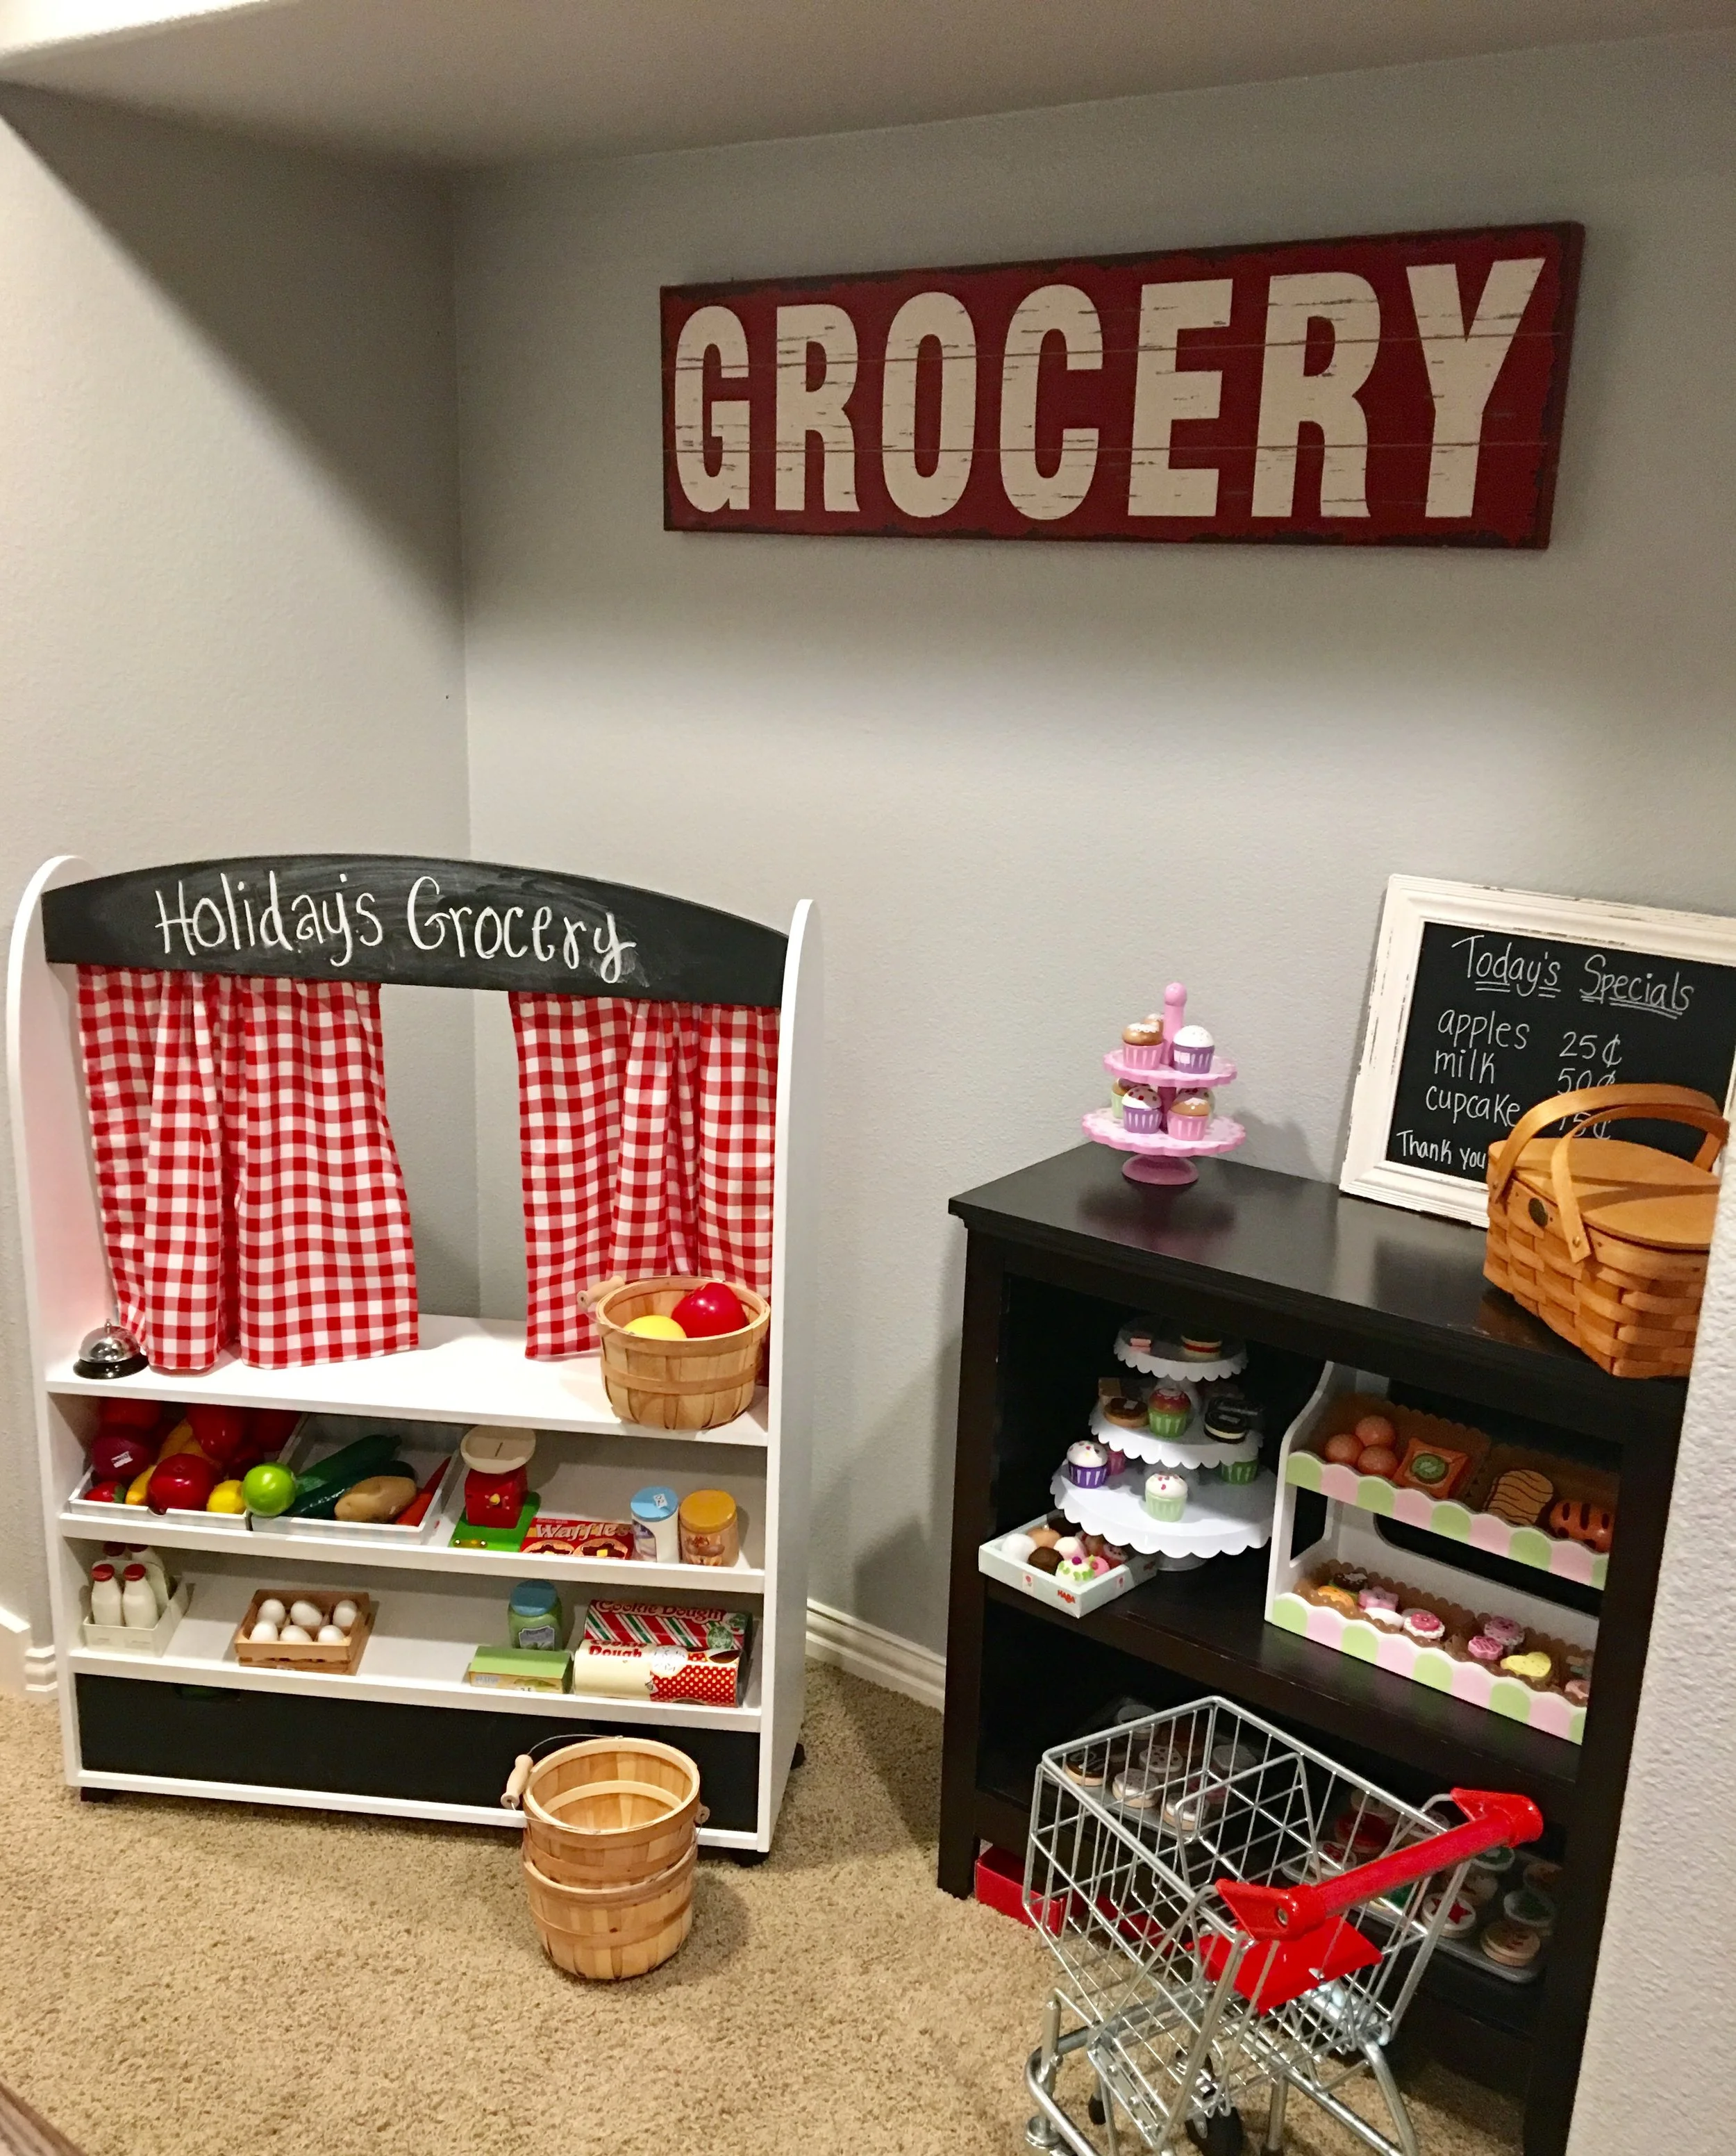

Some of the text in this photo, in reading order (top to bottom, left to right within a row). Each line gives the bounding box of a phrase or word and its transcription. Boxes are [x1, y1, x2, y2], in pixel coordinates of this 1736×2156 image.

[673, 257, 1546, 521] GROCERY
[406, 875, 637, 984] Grocery
[1451, 934, 1694, 1011] Today's Specials
[1437, 1009, 1623, 1068] apples 25¢
[1434, 1049, 1495, 1084] milk
[1426, 1085, 1520, 1127] cupcake
[1396, 1129, 1452, 1165] Thank
[598, 1600, 724, 1621] Cookie Dough
